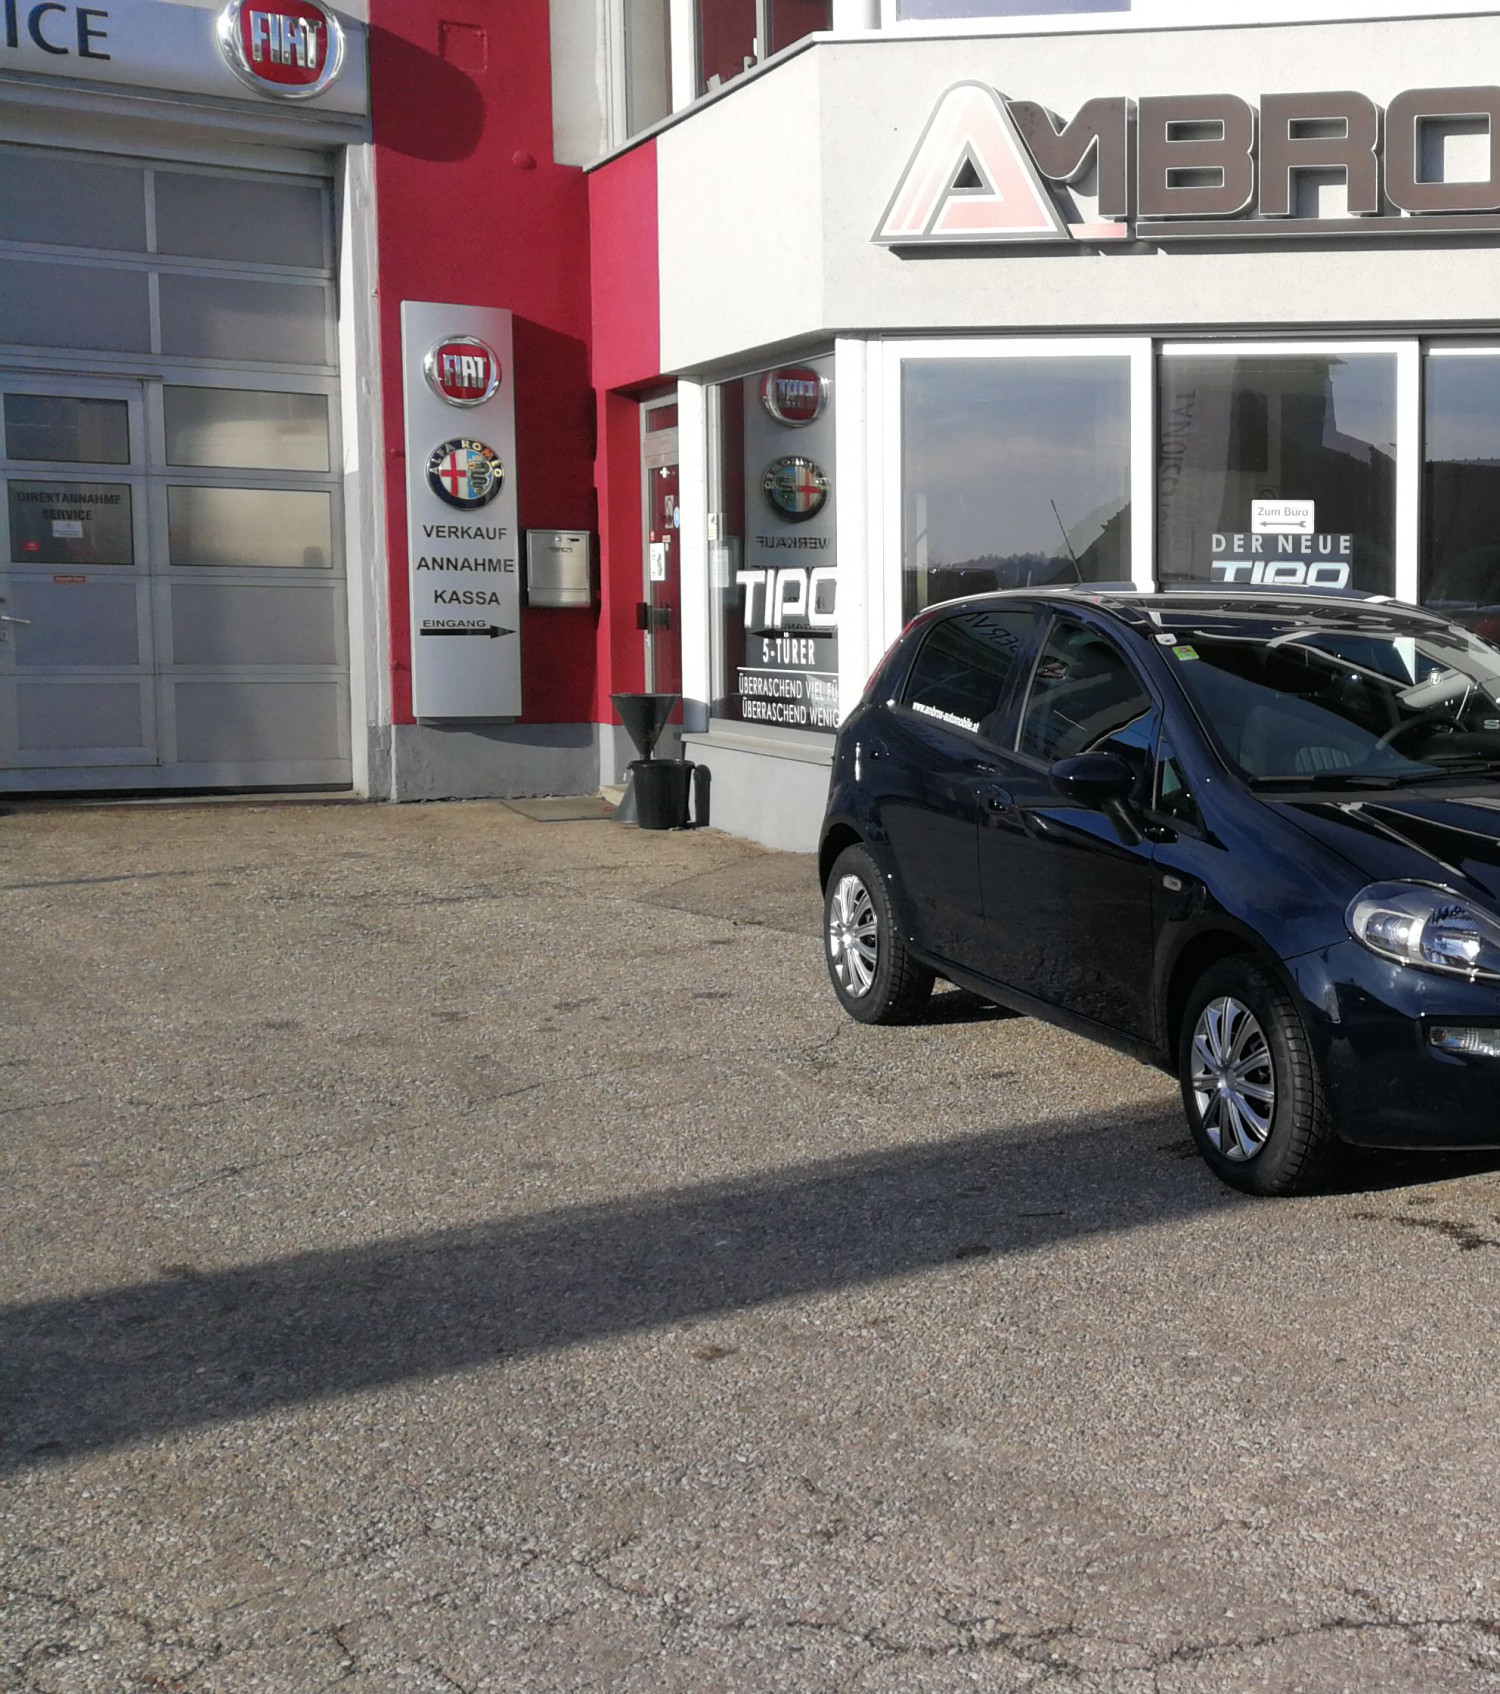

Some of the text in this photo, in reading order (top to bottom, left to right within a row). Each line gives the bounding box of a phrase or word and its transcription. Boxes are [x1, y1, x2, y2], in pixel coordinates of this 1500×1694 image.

[250, 10, 322, 69] FIAT
[443, 354, 487, 389] FIAT
[429, 439, 504, 478] ALFA ROMEO
[42, 509, 93, 520] SERVICE
[1257, 507, 1309, 517] Zum Büro
[423, 525, 508, 540] VERKAUF
[1212, 534, 1350, 554] DER NEUE
[416, 557, 515, 573] ANNAHME
[1212, 560, 1350, 589] TIPO
[434, 589, 500, 605] KASSA
[736, 566, 838, 629] TIPO
[763, 631, 816, 665] 5-TÜRER
[738, 672, 802, 699] ÜBERRASCHEND
[806, 680, 825, 701] VIEL
[742, 697, 840, 729] ÜBERRASCHEND WENIG
